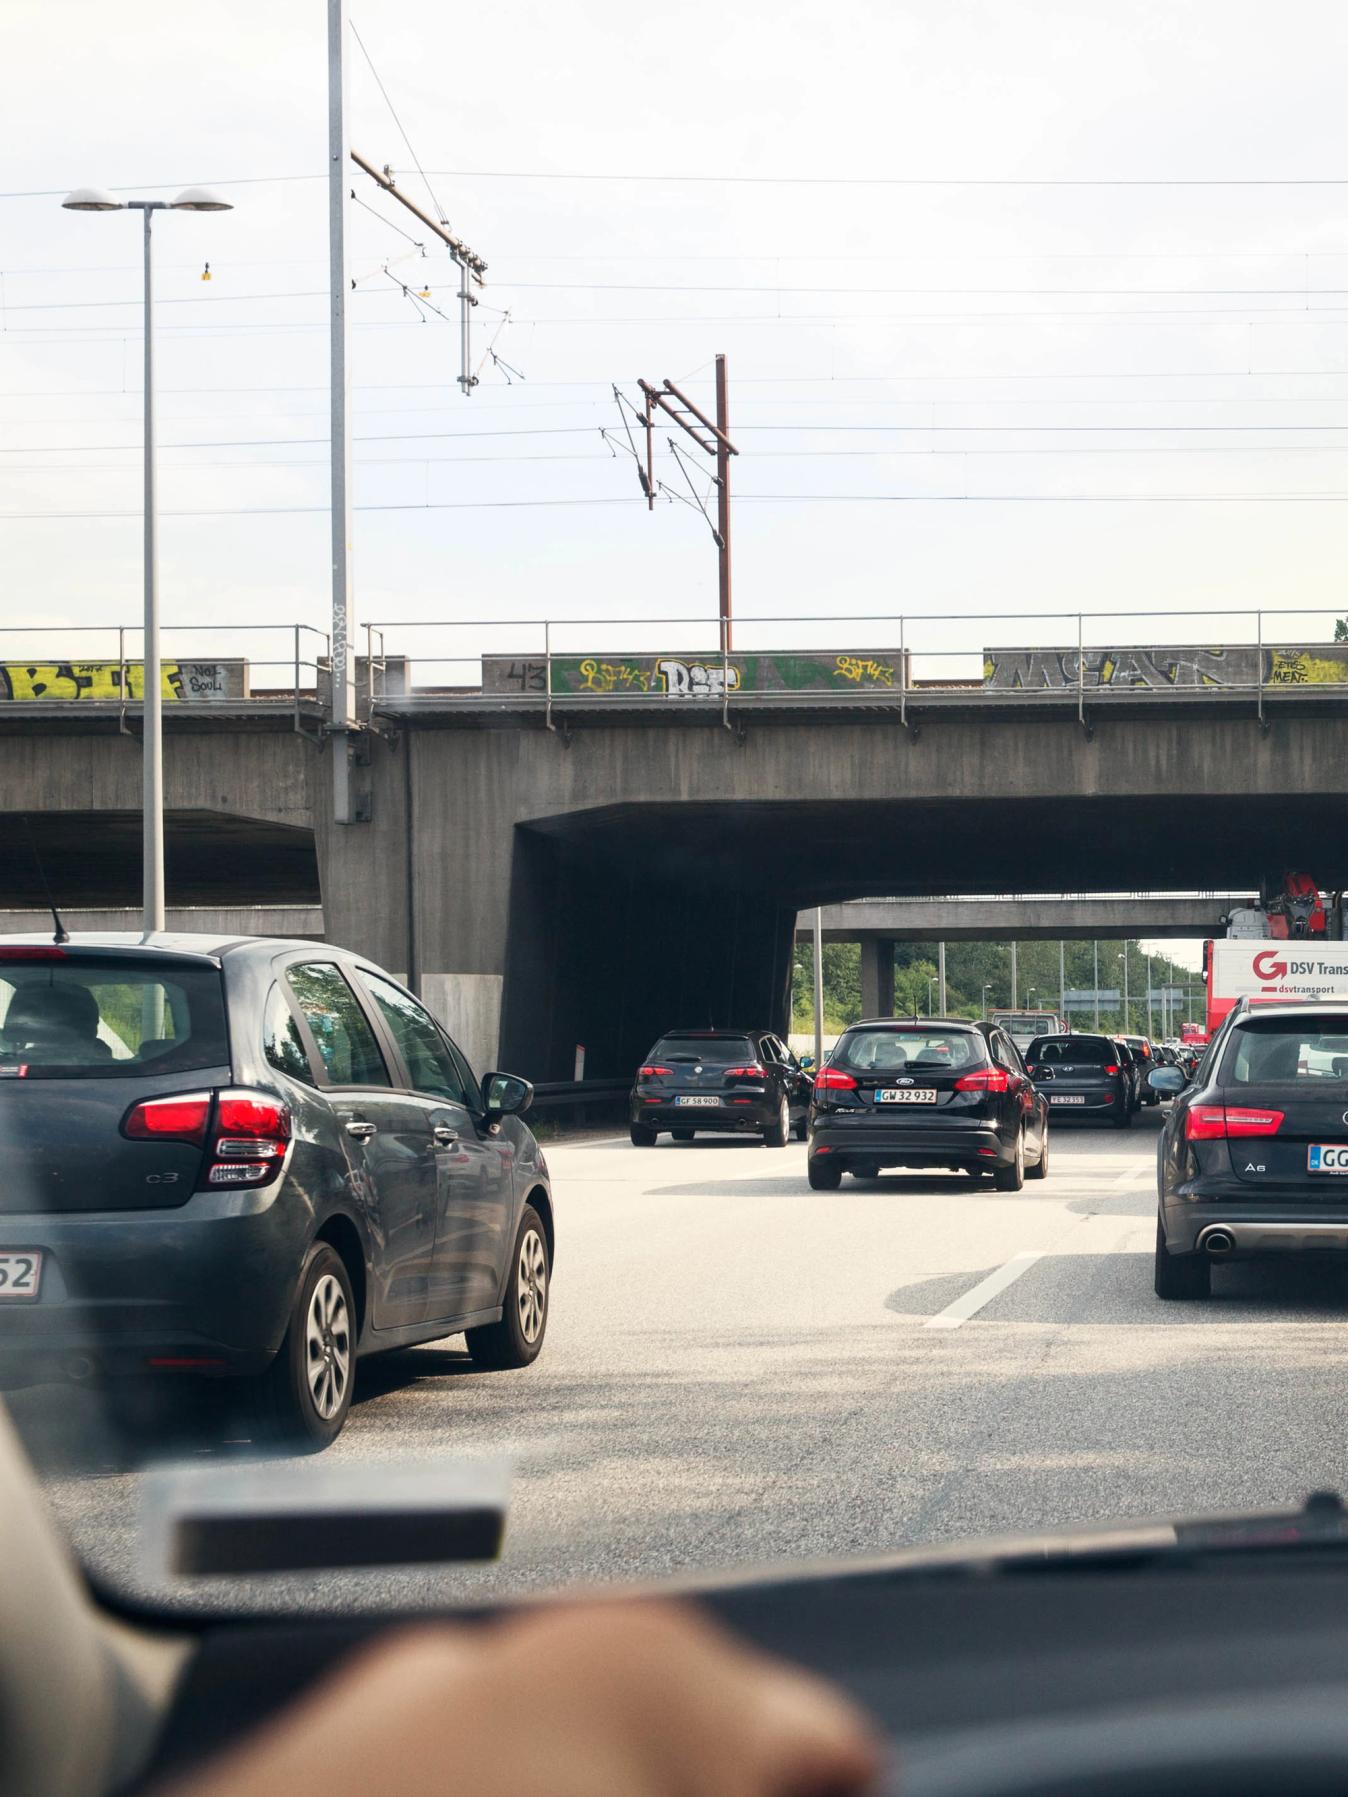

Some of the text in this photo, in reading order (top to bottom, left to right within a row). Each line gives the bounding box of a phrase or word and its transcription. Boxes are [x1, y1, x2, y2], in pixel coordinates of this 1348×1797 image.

[1290, 962, 1315, 975] DSV
[1278, 984, 1335, 994] dsvtransport
[881, 1091, 935, 1101] GW 32 932
[1244, 1162, 1267, 1172] A6
